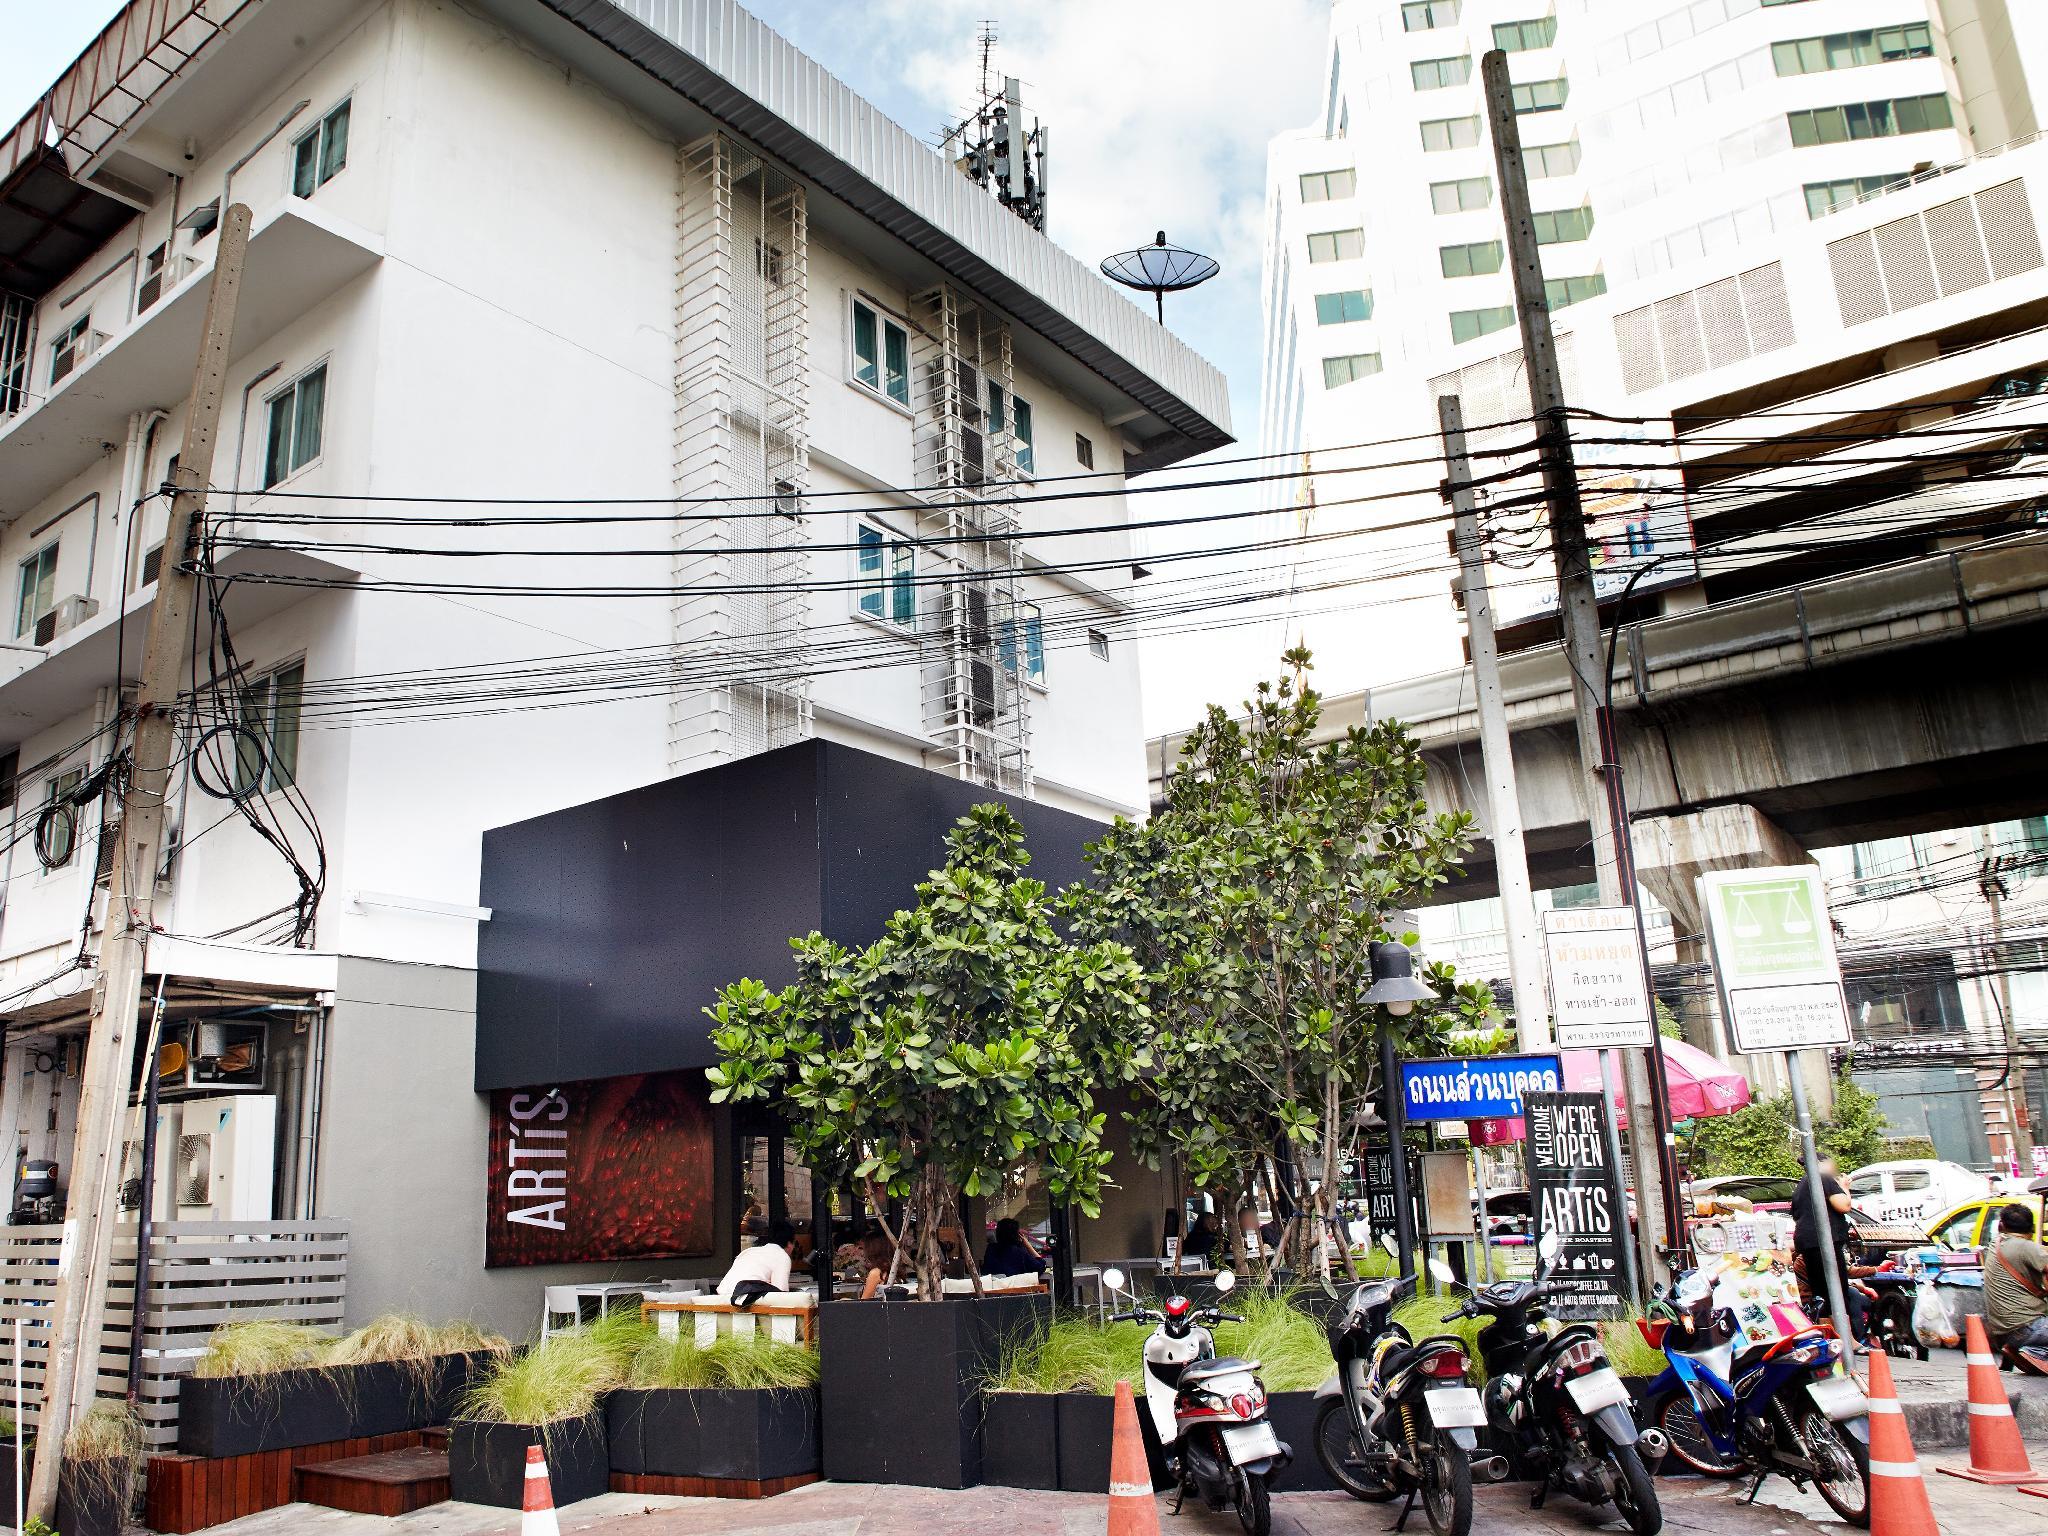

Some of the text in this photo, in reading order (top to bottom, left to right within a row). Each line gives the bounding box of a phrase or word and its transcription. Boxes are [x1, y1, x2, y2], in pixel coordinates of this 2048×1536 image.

[1409, 1061, 1558, 1114] ถนนส่วนบุคคล
[1533, 1104, 1554, 1168] WELCOME
[1552, 1105, 1599, 1134] WE'RE
[1555, 1133, 1604, 1167] OPEN
[1368, 1154, 1380, 1186] WELCOME
